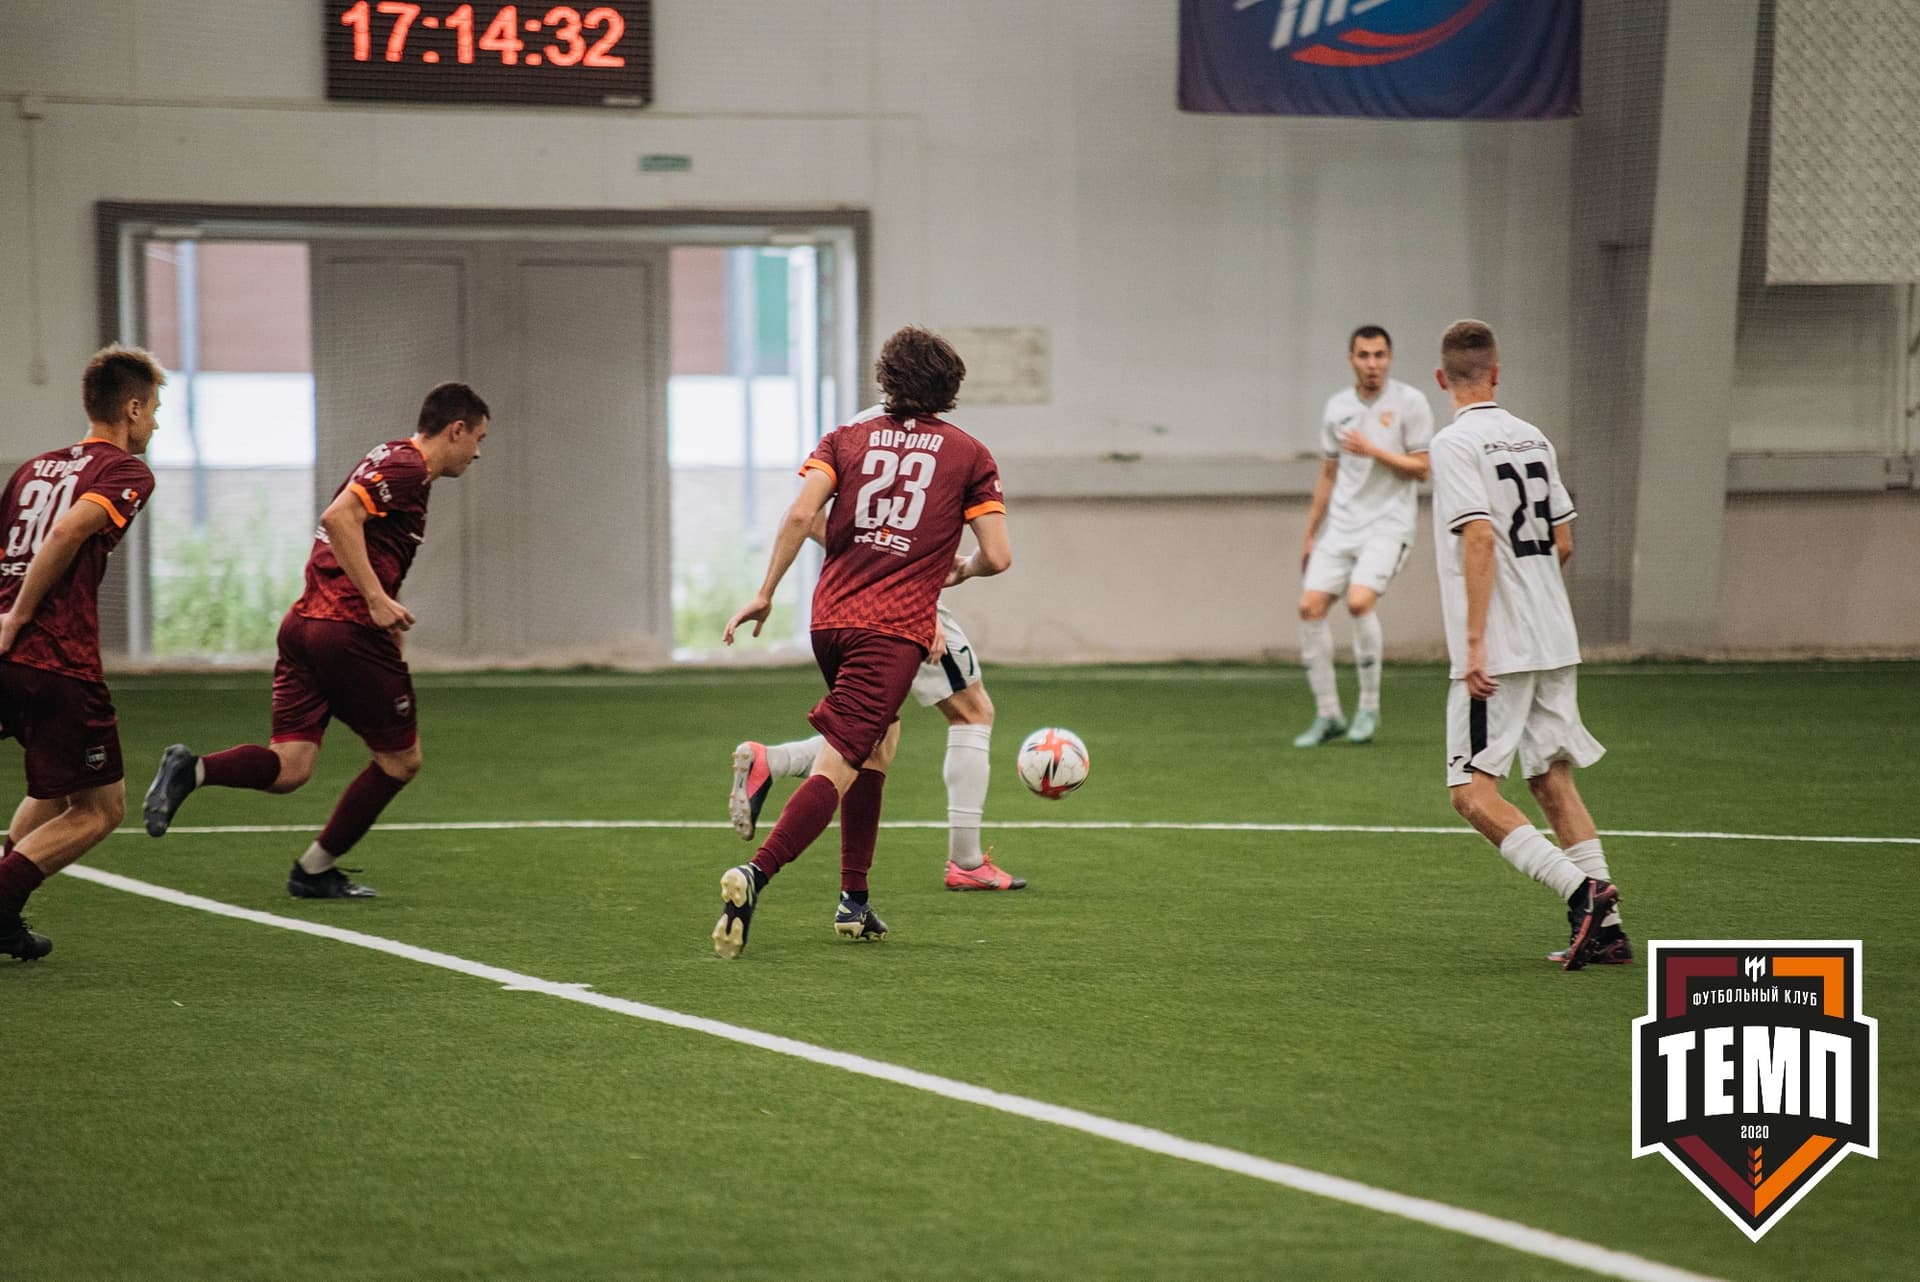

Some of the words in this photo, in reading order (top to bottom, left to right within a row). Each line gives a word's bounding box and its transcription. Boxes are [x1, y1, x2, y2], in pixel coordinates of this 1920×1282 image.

[341, 0, 626, 67] 17:14:32
[6, 475, 79, 557] 30
[855, 450, 937, 530] 23
[1496, 461, 1555, 558] 23
